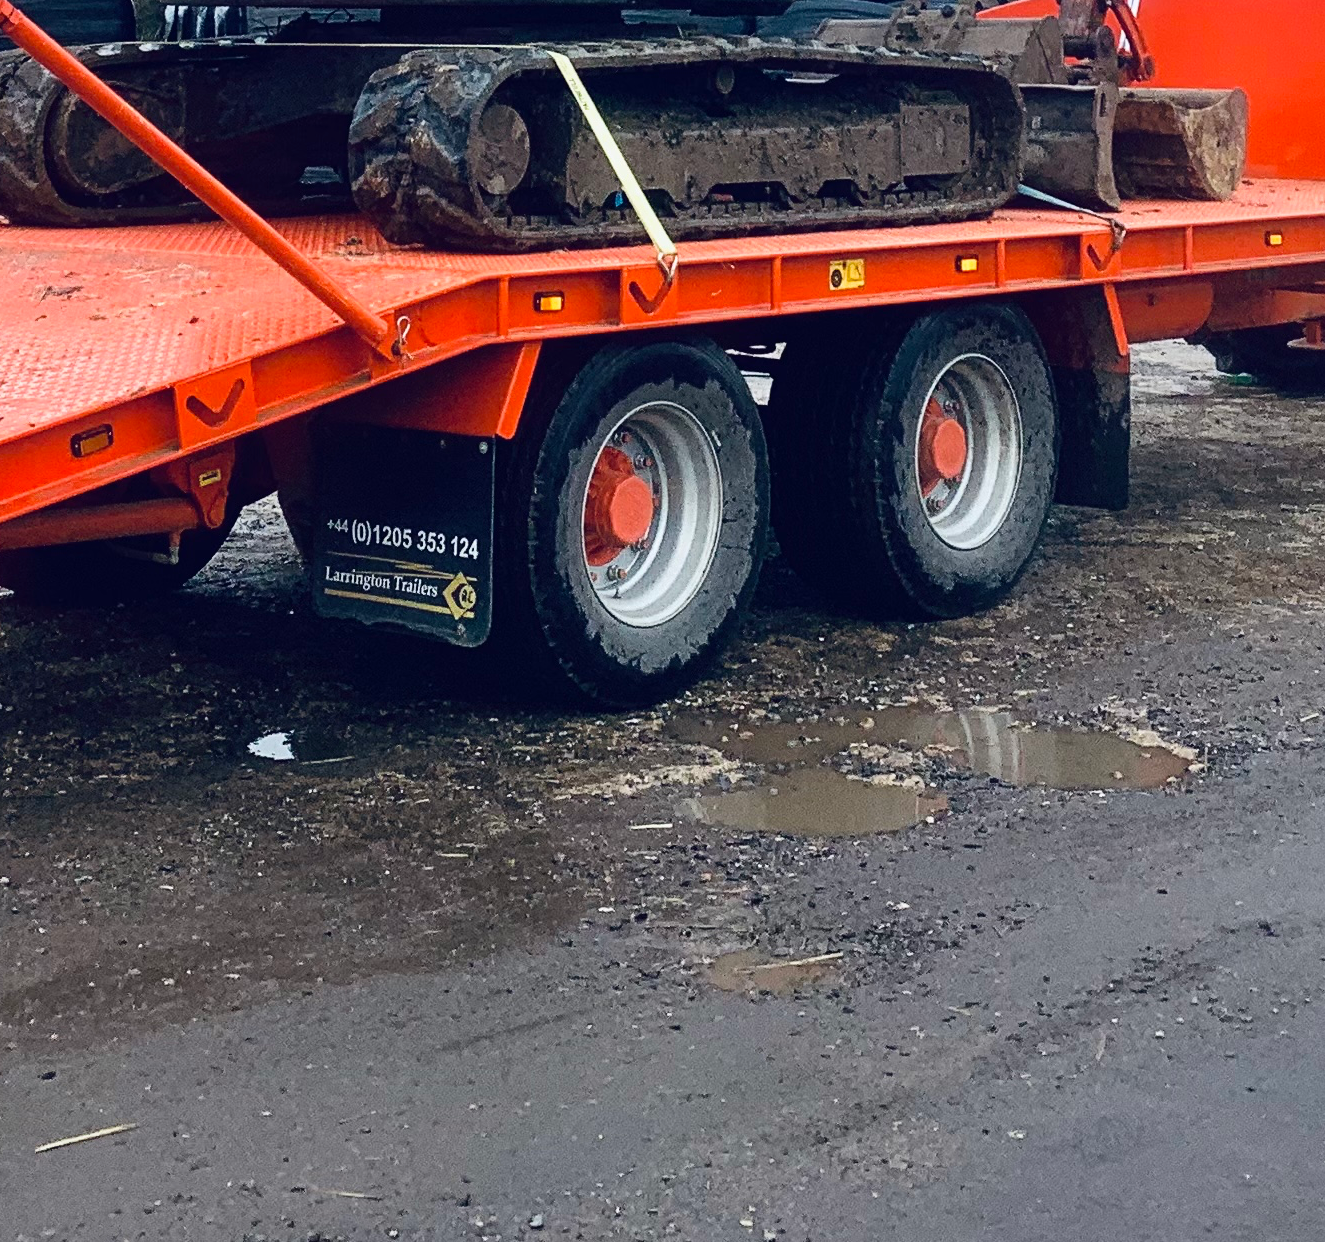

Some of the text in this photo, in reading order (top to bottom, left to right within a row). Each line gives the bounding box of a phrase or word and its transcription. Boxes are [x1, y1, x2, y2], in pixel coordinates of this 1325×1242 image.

[327, 518, 480, 560] +44 (0)1205 353 124
[325, 565, 438, 598] Larrington Trailers
